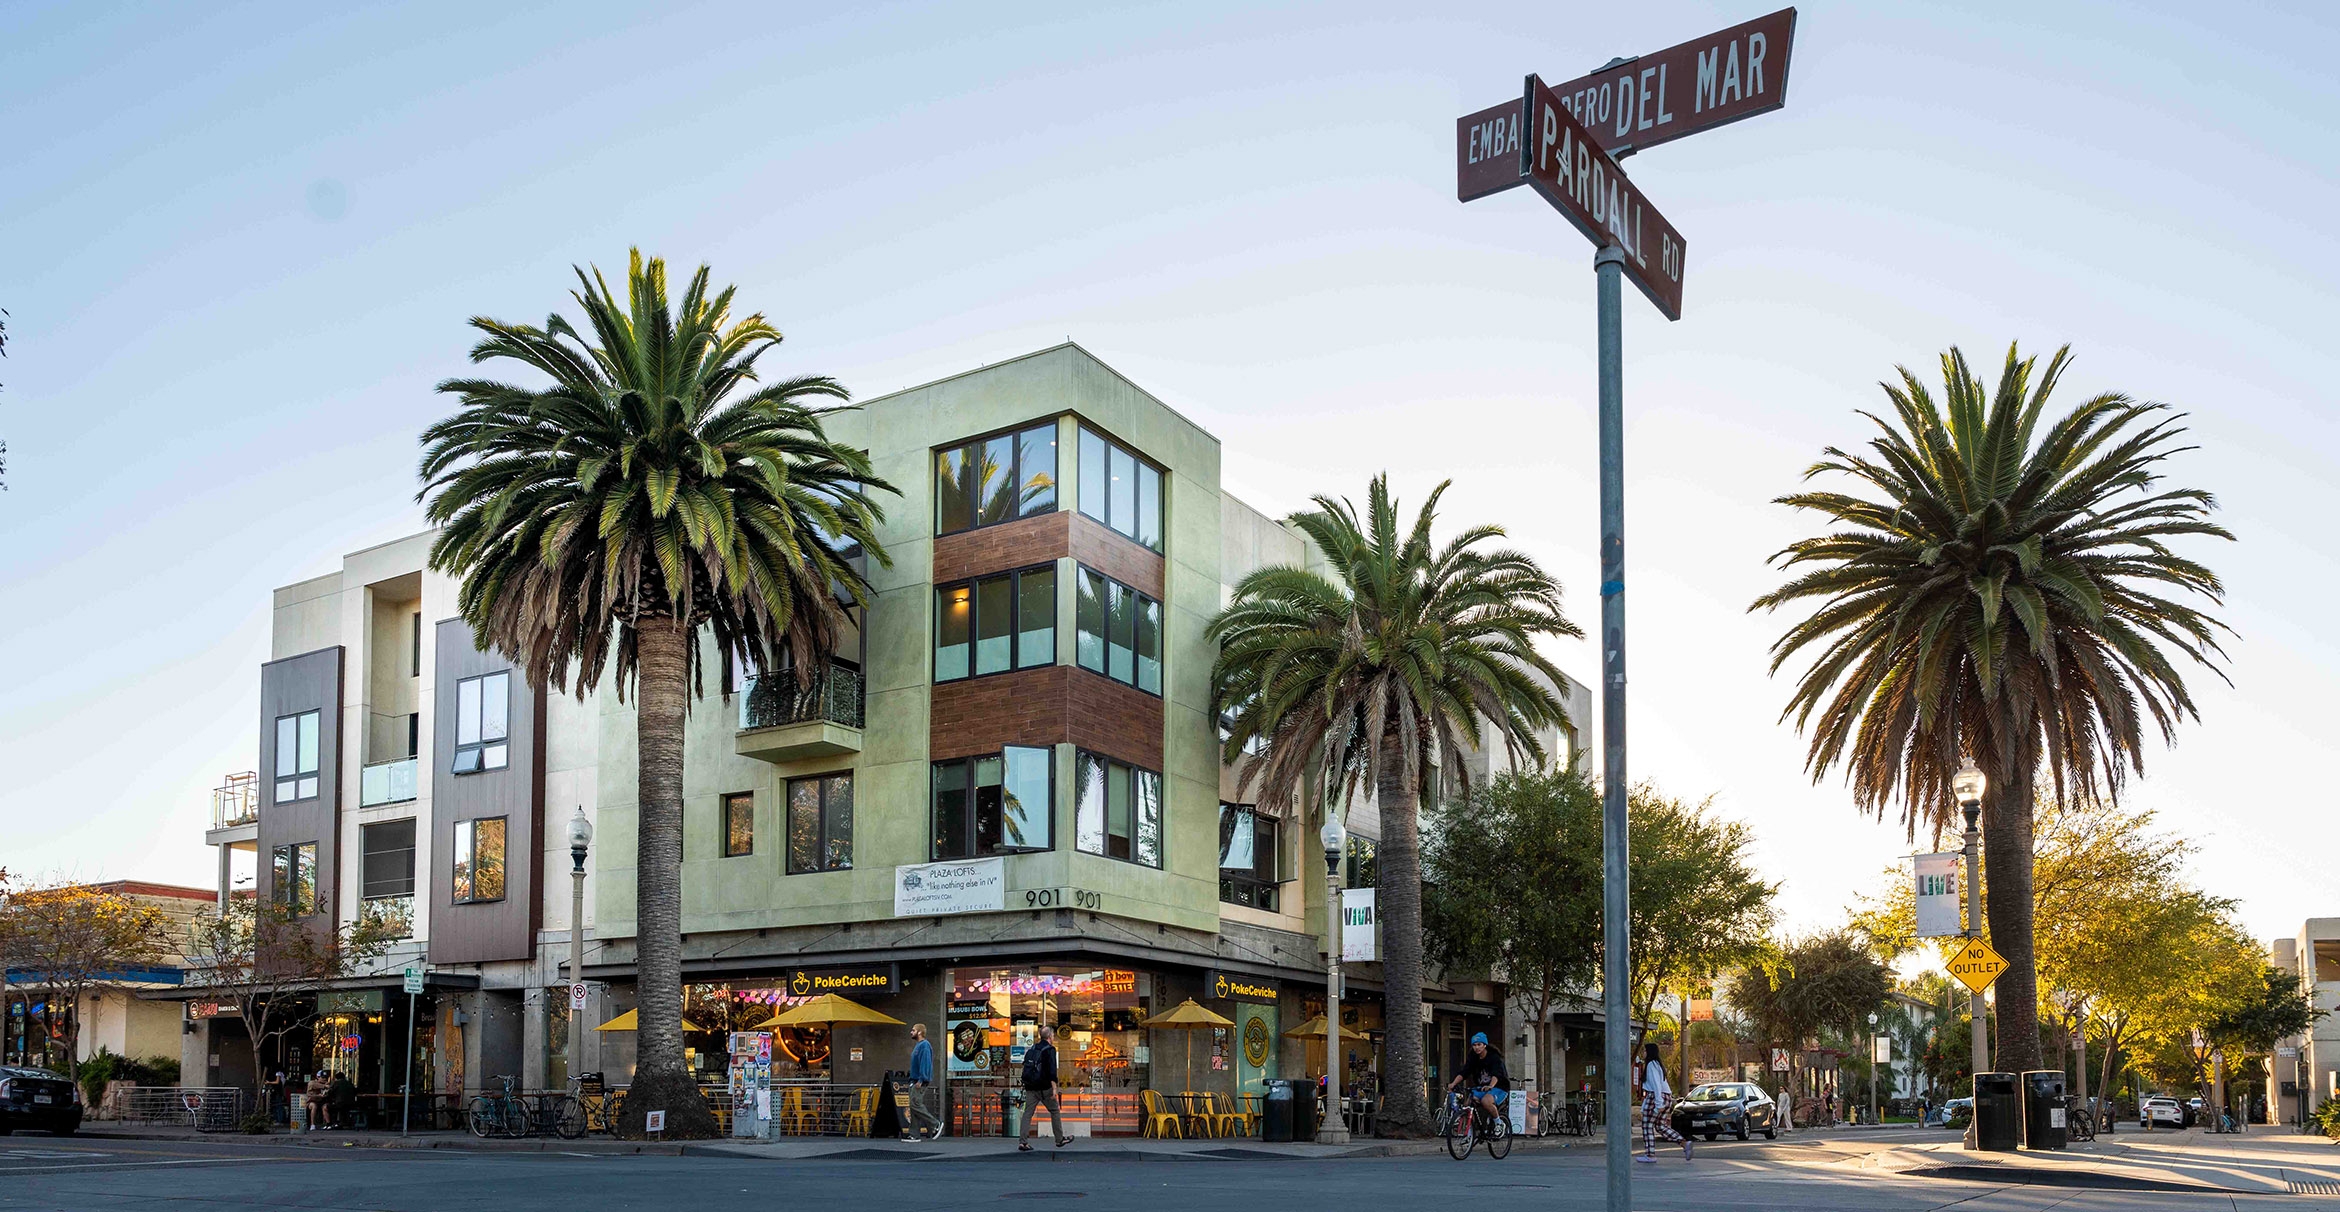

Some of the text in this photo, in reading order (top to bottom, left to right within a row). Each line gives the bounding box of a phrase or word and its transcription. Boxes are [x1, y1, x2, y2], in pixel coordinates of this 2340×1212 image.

[1616, 63, 1673, 138] DEL
[1695, 32, 1767, 113] MAR
[1541, 103, 1679, 283] PARDALL RD
[929, 868, 952, 879] PLAZA
[941, 880, 965, 890] nothing
[965, 878, 979, 887] else
[979, 878, 986, 886] in
[1918, 873, 1956, 896] LIVE
[1026, 888, 1060, 907] 901
[1076, 889, 1101, 910] 901
[1344, 906, 1373, 926] VIVA
[1968, 949, 1984, 959] NO
[1954, 962, 2000, 974] OUTLET
[814, 973, 887, 988] PokeCeviche
[1230, 982, 1277, 999] PokeCeviche
[947, 1006, 971, 1014] MUSUBI
[971, 1005, 988, 1013] BOWL
